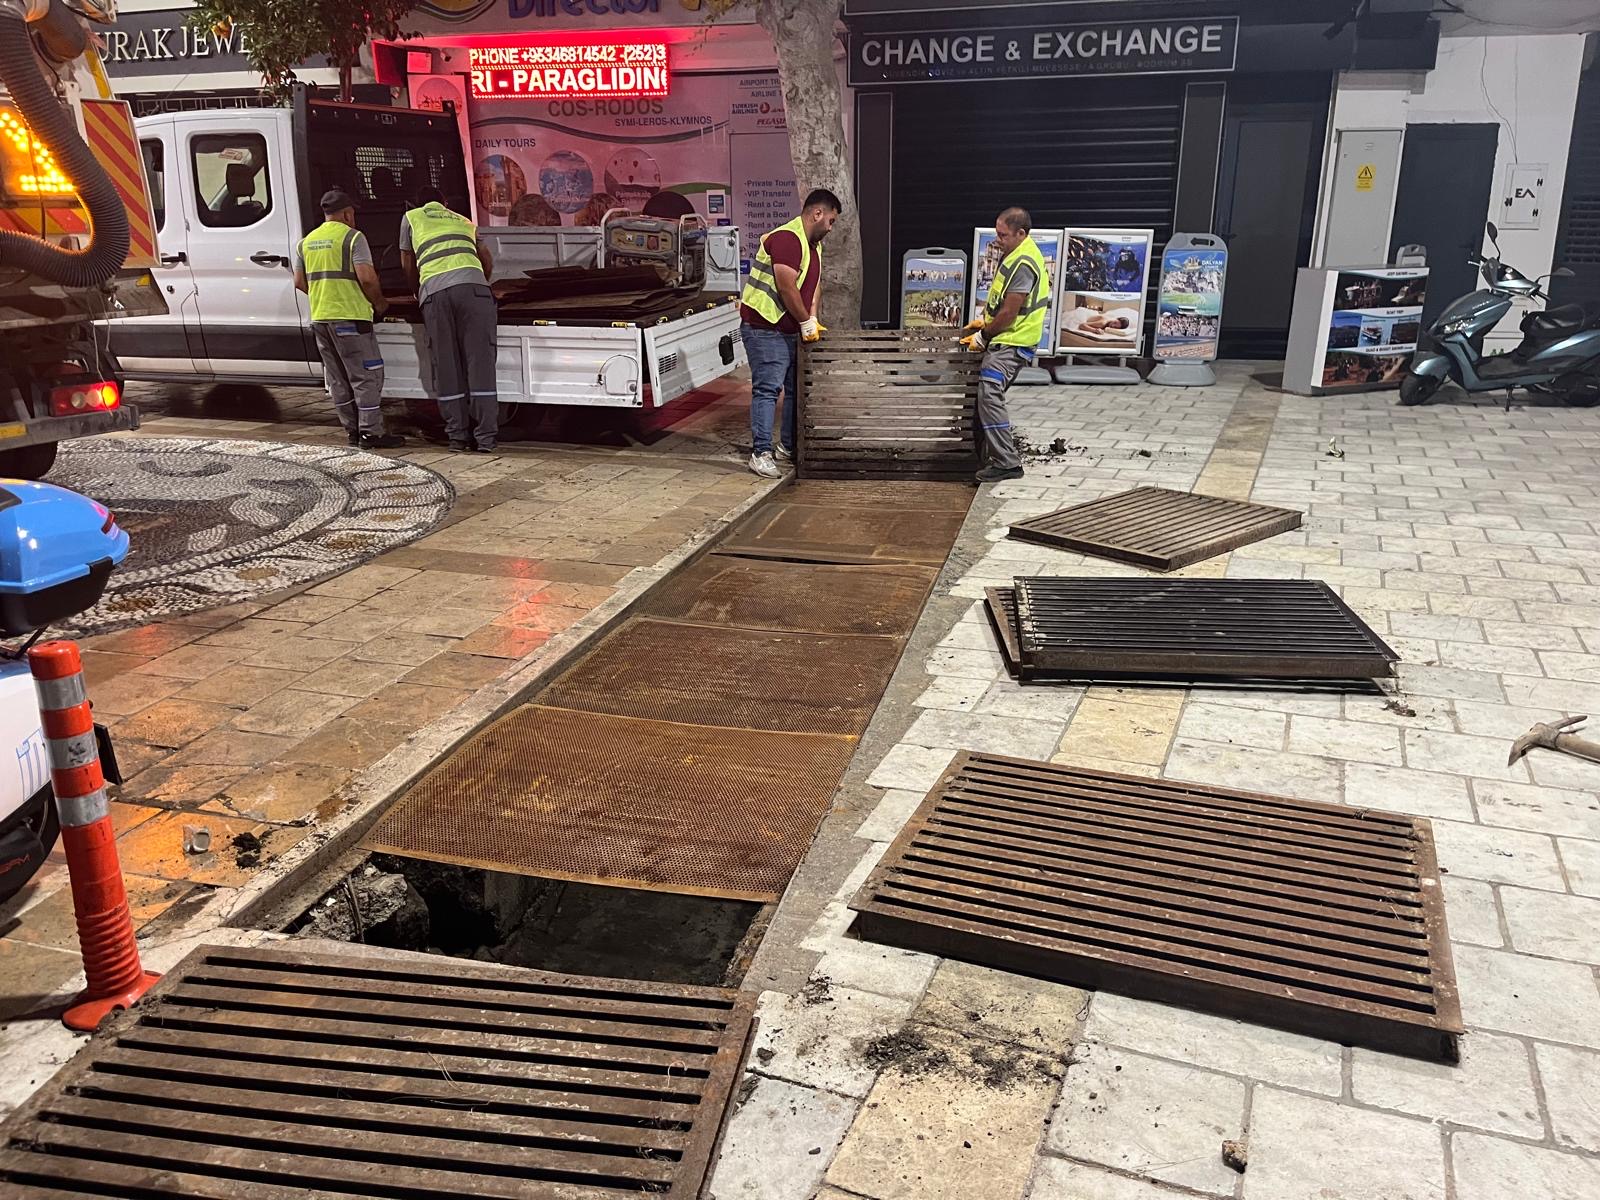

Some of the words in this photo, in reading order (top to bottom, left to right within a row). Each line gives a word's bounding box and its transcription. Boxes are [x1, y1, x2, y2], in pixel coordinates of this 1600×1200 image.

[96, 28, 174, 62] URAK
[179, 22, 254, 57] JEWE
[862, 35, 995, 67] CHANGE
[1005, 40, 1021, 61] &
[1033, 25, 1222, 60] EXCHANGE
[470, 47, 519, 64] PHONE
[548, 99, 664, 117] COS-RODOS
[615, 116, 713, 127] SYMI-LEROS-KLYMNOS
[475, 138, 501, 149] DAILY
[505, 138, 536, 148] TOURS
[748, 221, 765, 229] Rent
